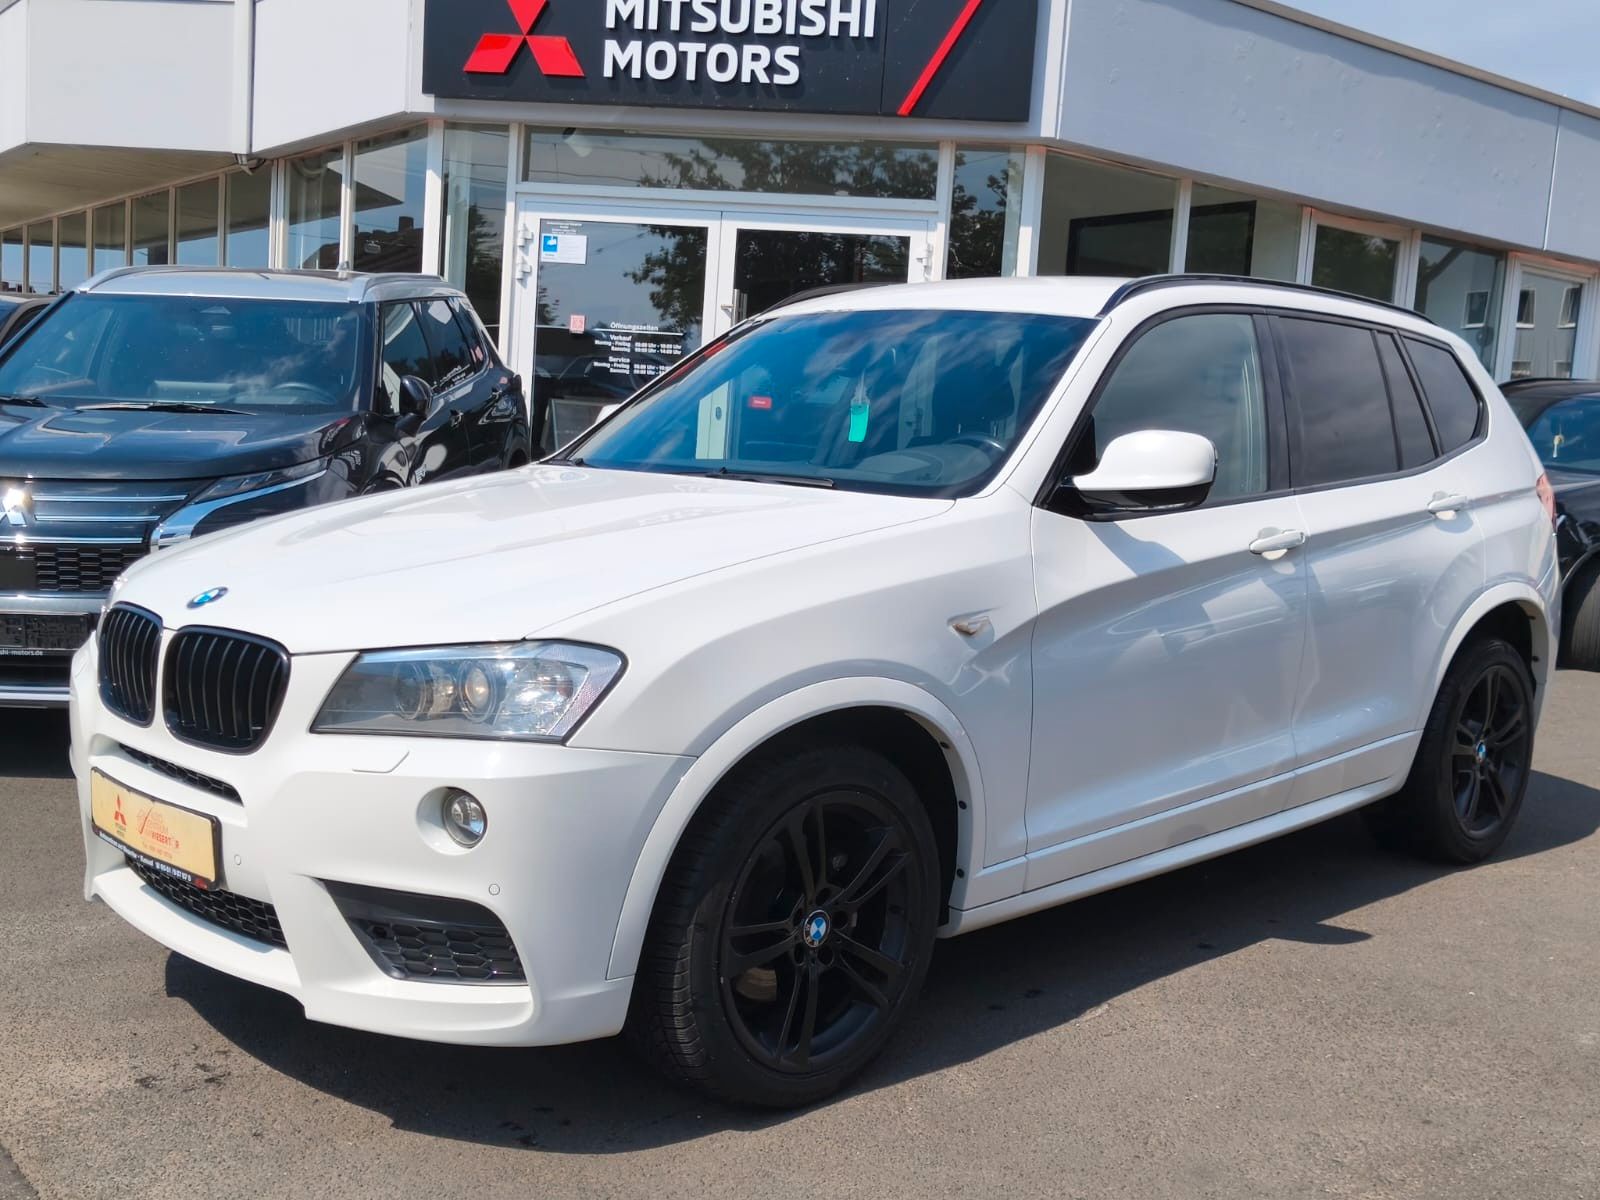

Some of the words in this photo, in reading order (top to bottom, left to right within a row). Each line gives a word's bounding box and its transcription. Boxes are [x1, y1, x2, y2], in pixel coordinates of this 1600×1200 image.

[605, 0, 876, 38] MITSUBISHI
[603, 39, 800, 85] MOTORS
[610, 322, 659, 331] Öffnungszeiten
